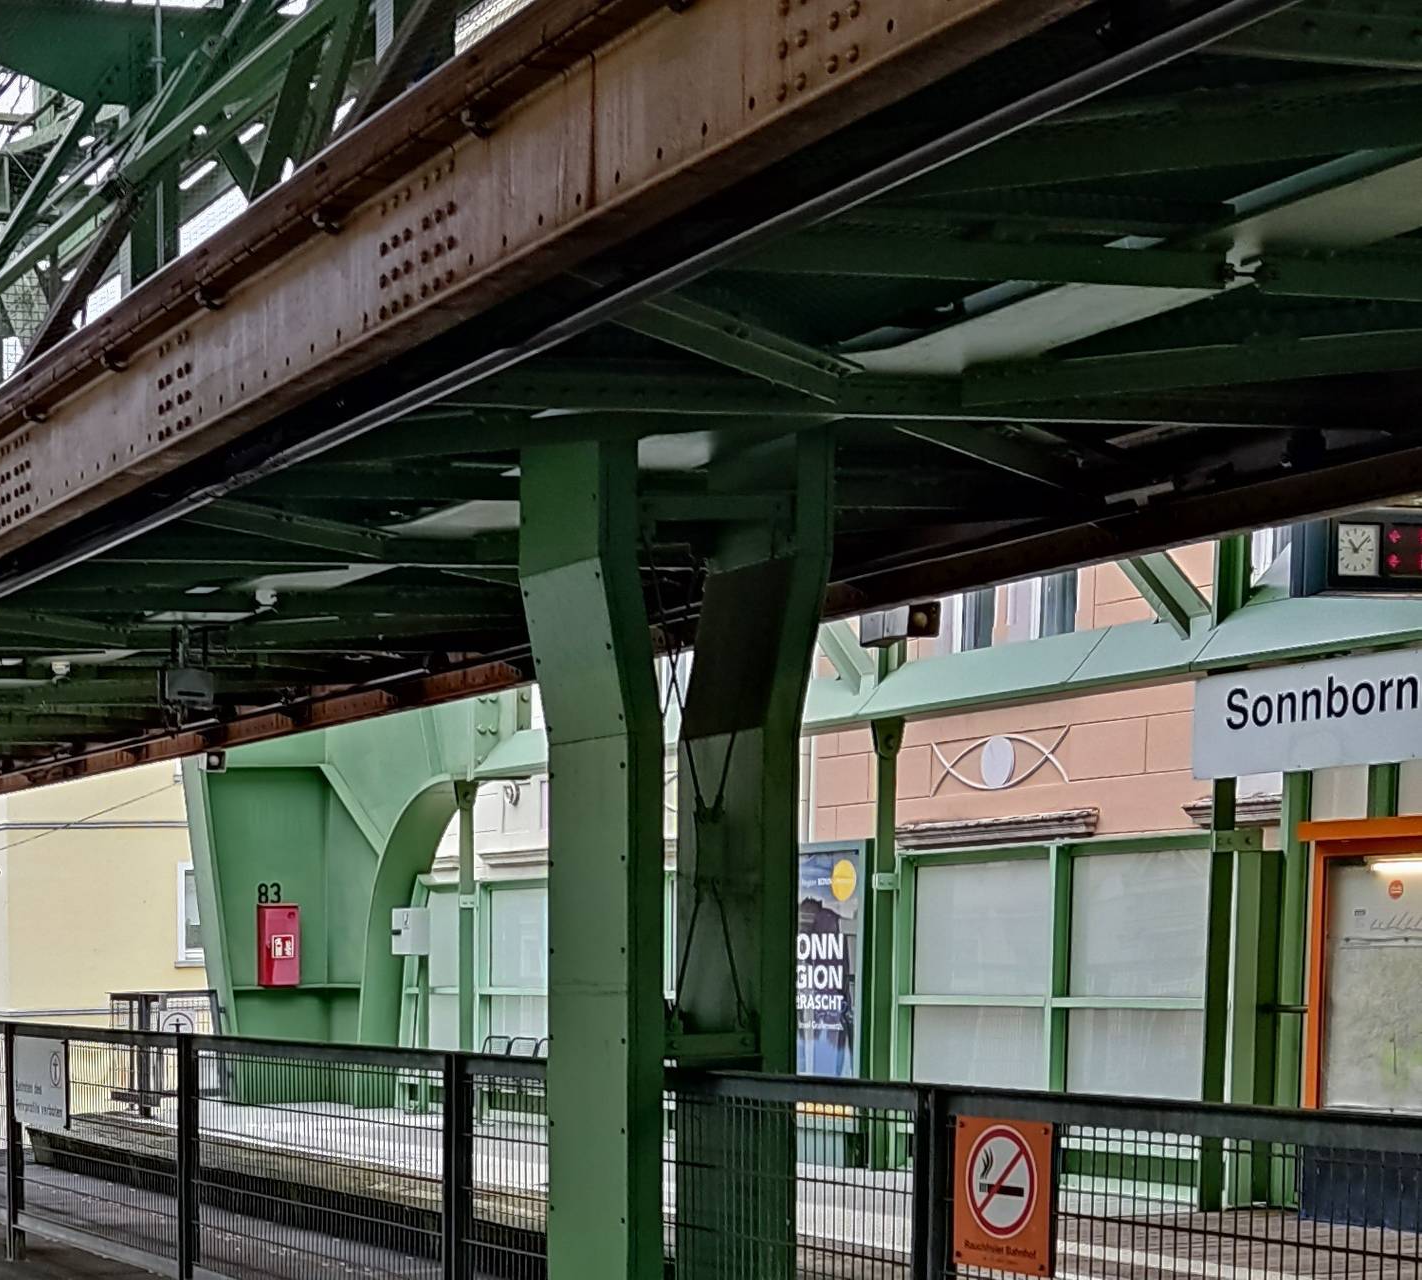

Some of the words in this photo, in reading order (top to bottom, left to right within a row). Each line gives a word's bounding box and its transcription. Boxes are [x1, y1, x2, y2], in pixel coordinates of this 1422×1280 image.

[1226, 674, 1419, 730] Sonnborn
[258, 883, 281, 903] 83
[796, 933, 844, 961] ONN
[796, 965, 843, 989] GION
[796, 995, 844, 1010] RASCHT
